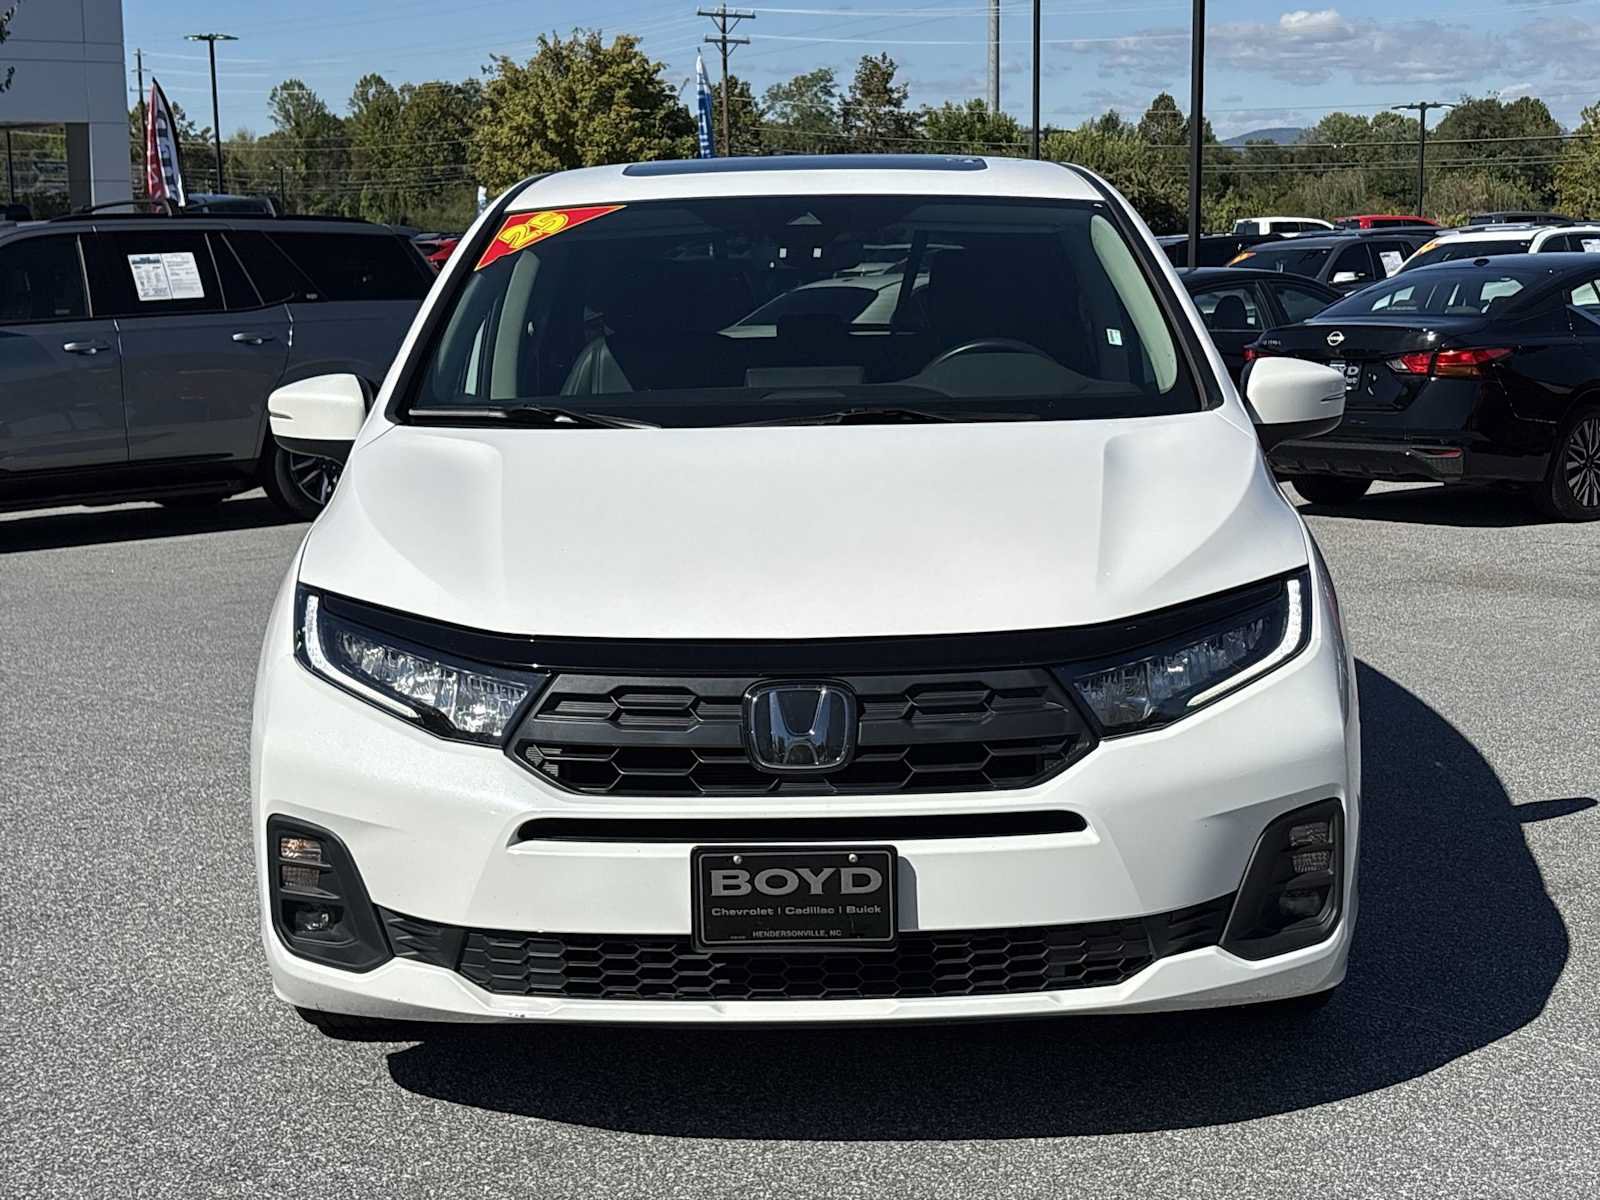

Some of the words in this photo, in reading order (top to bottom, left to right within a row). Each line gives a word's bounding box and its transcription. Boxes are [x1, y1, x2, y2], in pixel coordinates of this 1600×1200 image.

[498, 211, 569, 249] 25
[710, 867, 883, 897] BOYD
[711, 906, 775, 917] Chevrolet
[784, 905, 836, 916] Cadillac
[846, 904, 882, 915] Buick
[752, 929, 829, 938] HENDERSONVILLE,
[829, 929, 843, 937] NC
